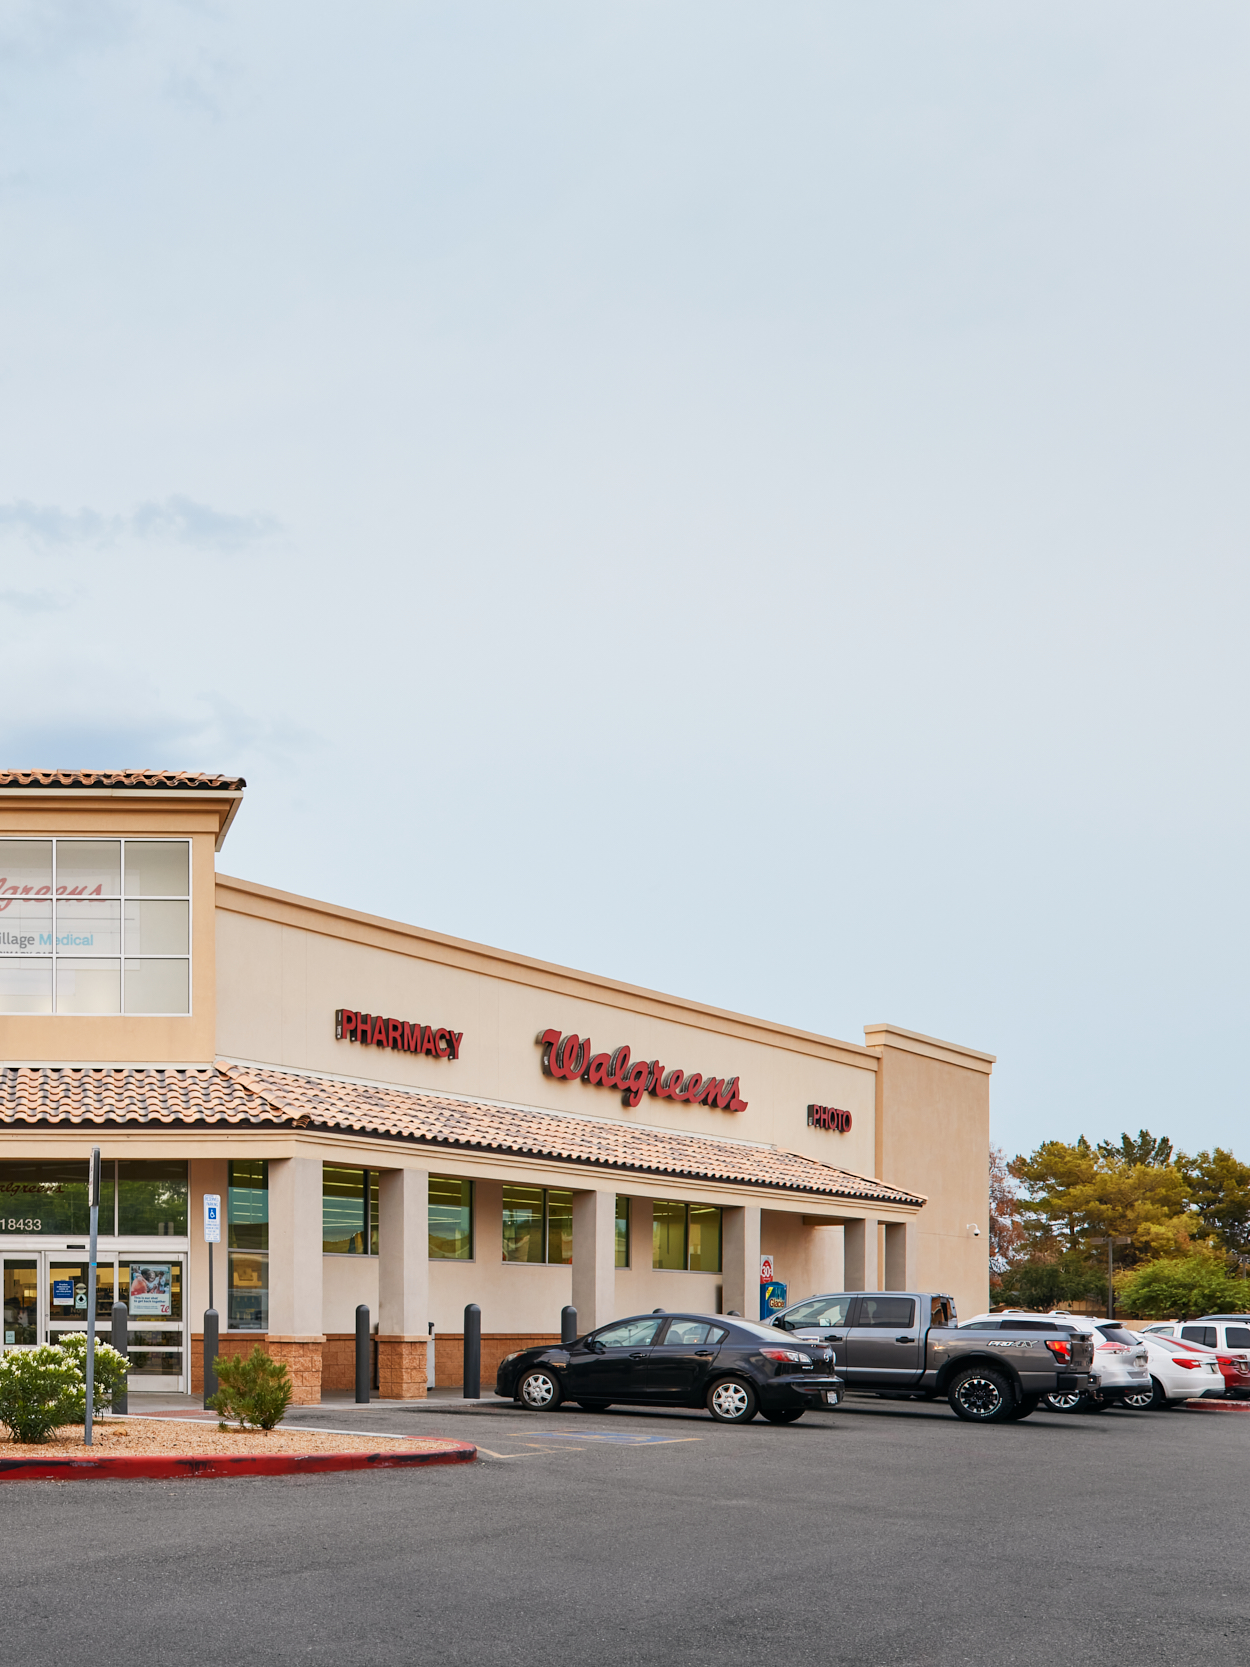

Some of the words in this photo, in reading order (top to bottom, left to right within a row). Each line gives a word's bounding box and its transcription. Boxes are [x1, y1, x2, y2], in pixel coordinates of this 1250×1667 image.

[39, 933, 94, 946] Medical
[339, 1009, 464, 1061] PHARMACY
[535, 1029, 748, 1112] Walgreens
[810, 1104, 853, 1132] PHOTO
[0, 1218, 42, 1231] 18433
